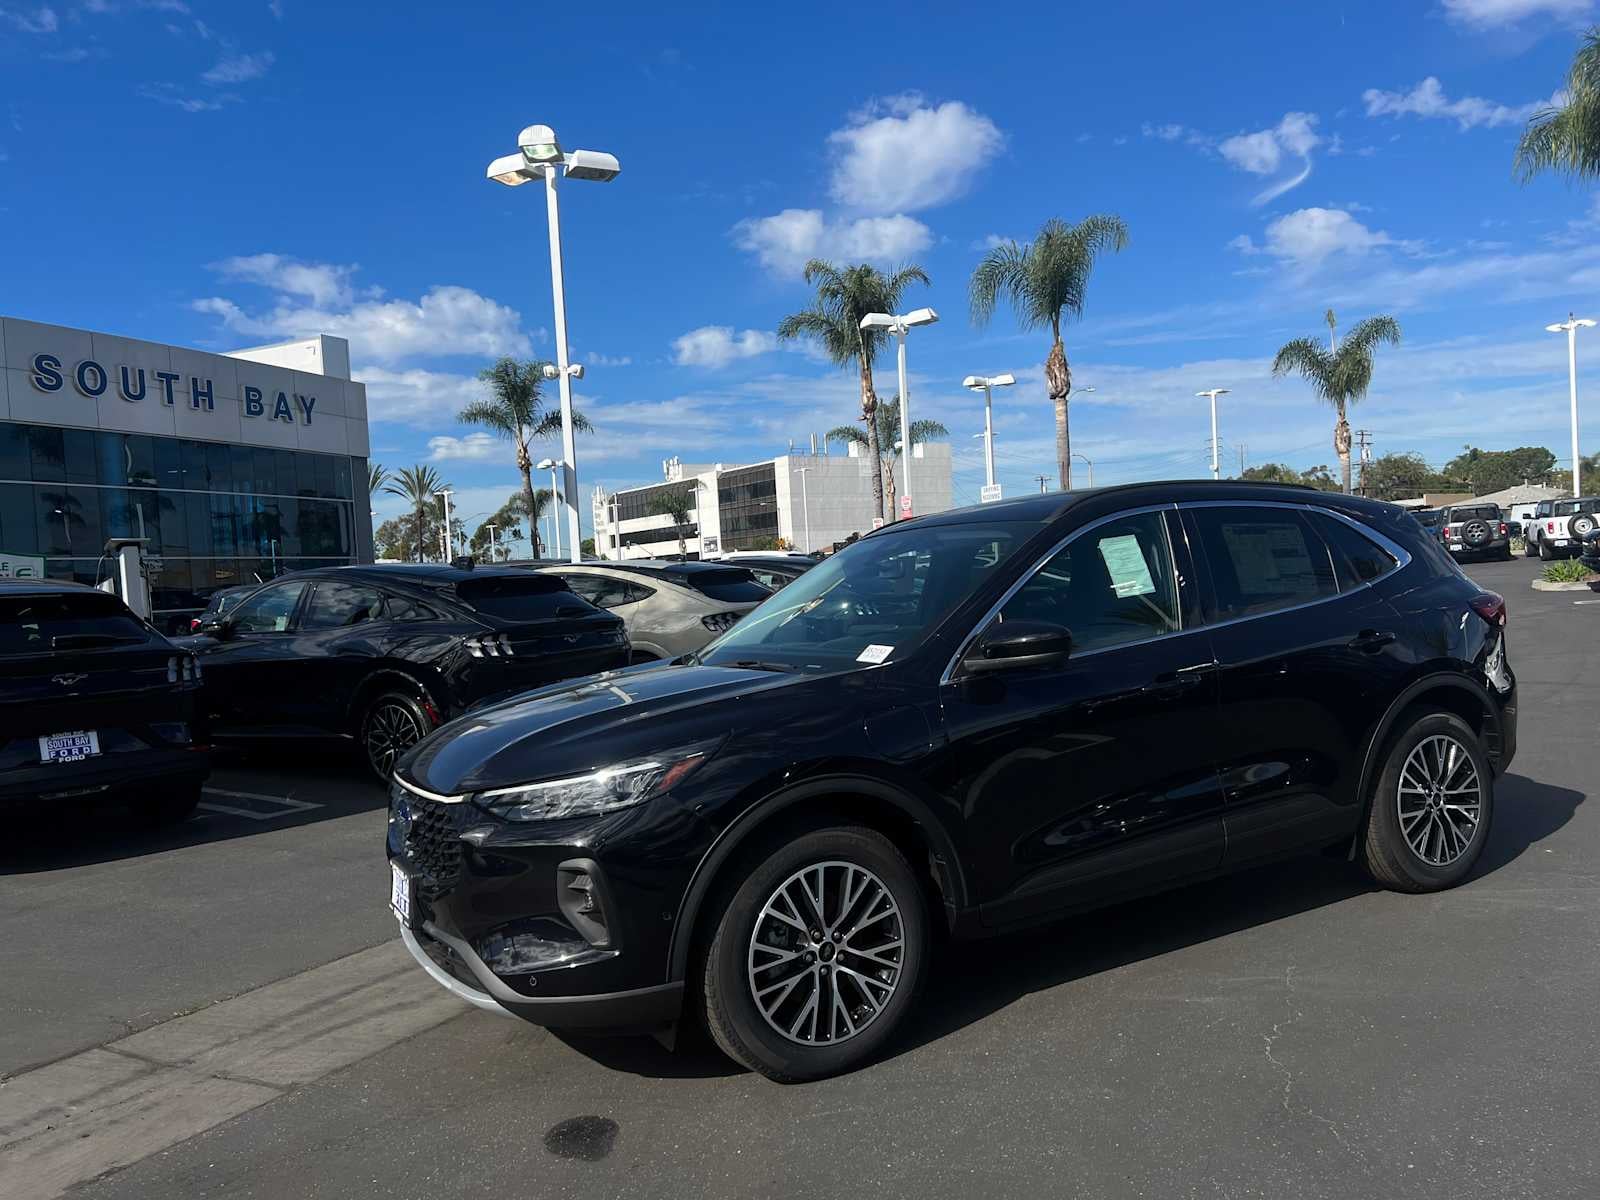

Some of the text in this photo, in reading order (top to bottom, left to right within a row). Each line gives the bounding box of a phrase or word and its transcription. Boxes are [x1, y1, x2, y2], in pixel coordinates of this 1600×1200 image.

[32, 353, 317, 425] SOUTH BAY
[48, 736, 89, 749] SOUTH BAY
[50, 747, 91, 759] FORD
[59, 754, 86, 763] FORD
